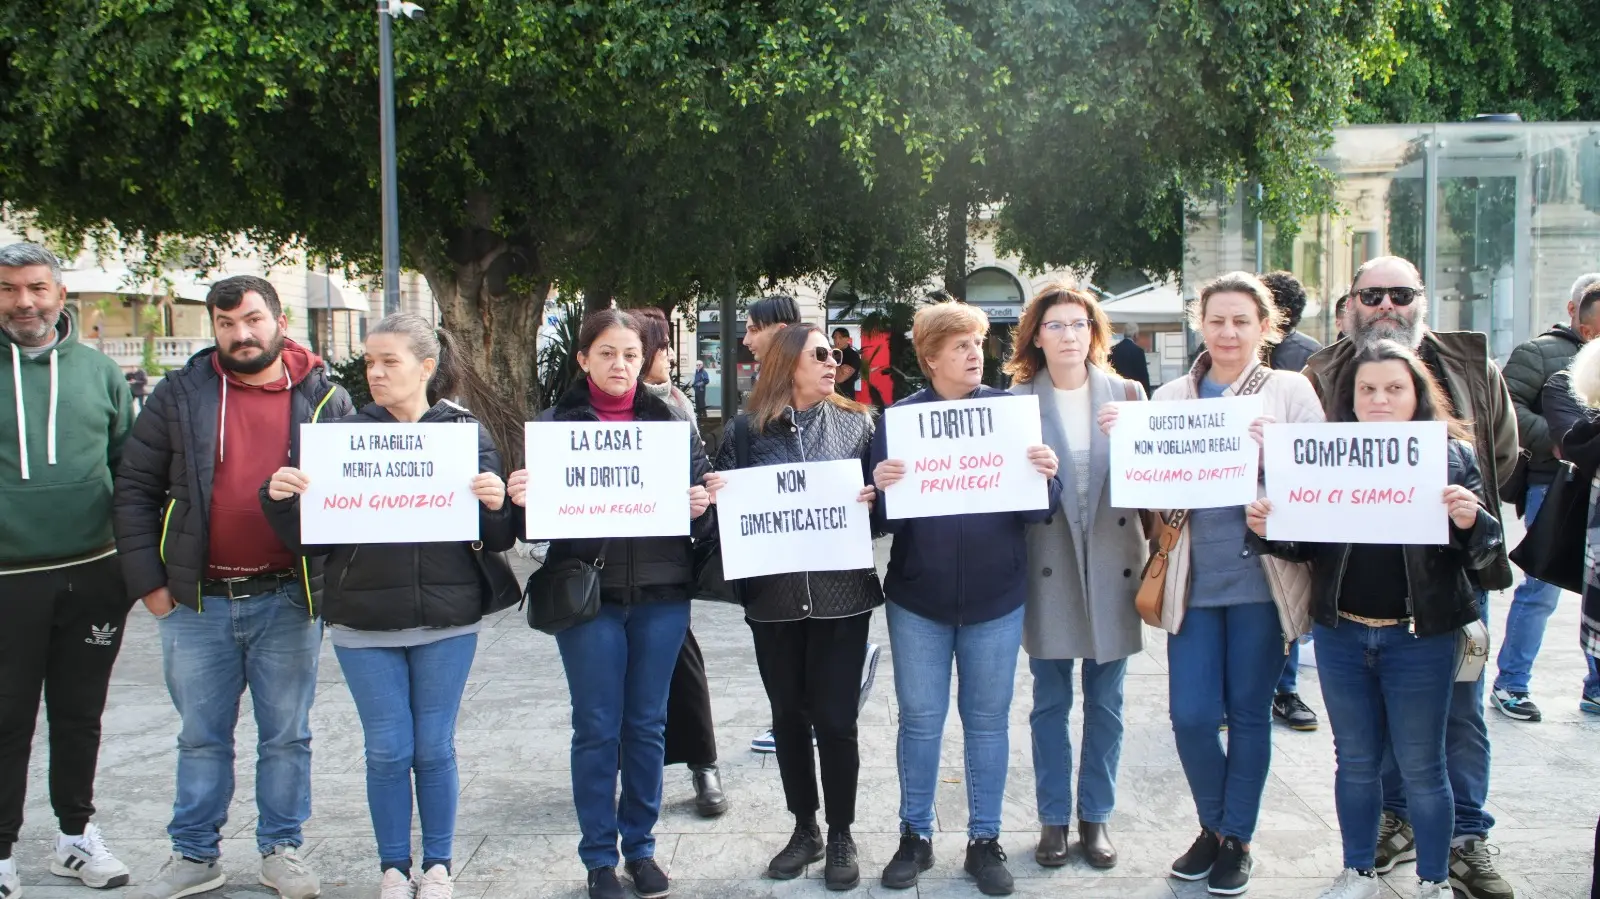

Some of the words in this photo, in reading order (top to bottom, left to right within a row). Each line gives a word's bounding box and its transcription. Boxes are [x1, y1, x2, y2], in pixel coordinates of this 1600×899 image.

[919, 413, 925, 438] I
[930, 407, 993, 439] DIRITTI
[1149, 415, 1185, 431] QUESTO
[1188, 413, 1225, 430] NATALE
[350, 435, 365, 451] LA
[370, 434, 425, 450] FRAGILITA'
[571, 430, 590, 451] LA
[595, 430, 631, 450] CASA
[636, 427, 642, 450] È
[1135, 440, 1154, 454] NON
[1157, 439, 1206, 455] VOGLIAMO
[1209, 437, 1240, 452] REGALI
[1294, 437, 1401, 468] COMPARTO
[1407, 437, 1420, 467] 6
[343, 462, 382, 478] MERITA
[386, 461, 433, 477] ASCOLTO
[915, 456, 951, 473] NON
[960, 452, 1003, 470] SONO
[566, 467, 585, 487] UN
[591, 466, 643, 489] DIRITTO,
[777, 470, 807, 494] NON
[921, 470, 1000, 493] PRIVILEGI!
[1126, 468, 1193, 482] VOGLIAMO
[1198, 464, 1246, 480] DIRITTI!
[324, 494, 362, 509] NON
[369, 492, 454, 508] GIUDIZIO!
[1289, 487, 1321, 503] NOI
[1328, 489, 1343, 504] CI
[1351, 487, 1415, 504] SIAMO!
[559, 504, 584, 515] NON
[590, 504, 605, 514] UN
[610, 503, 656, 513] REGALO!
[740, 506, 847, 536] DIMENTICATECI!
[84, 637, 112, 646] adidas
